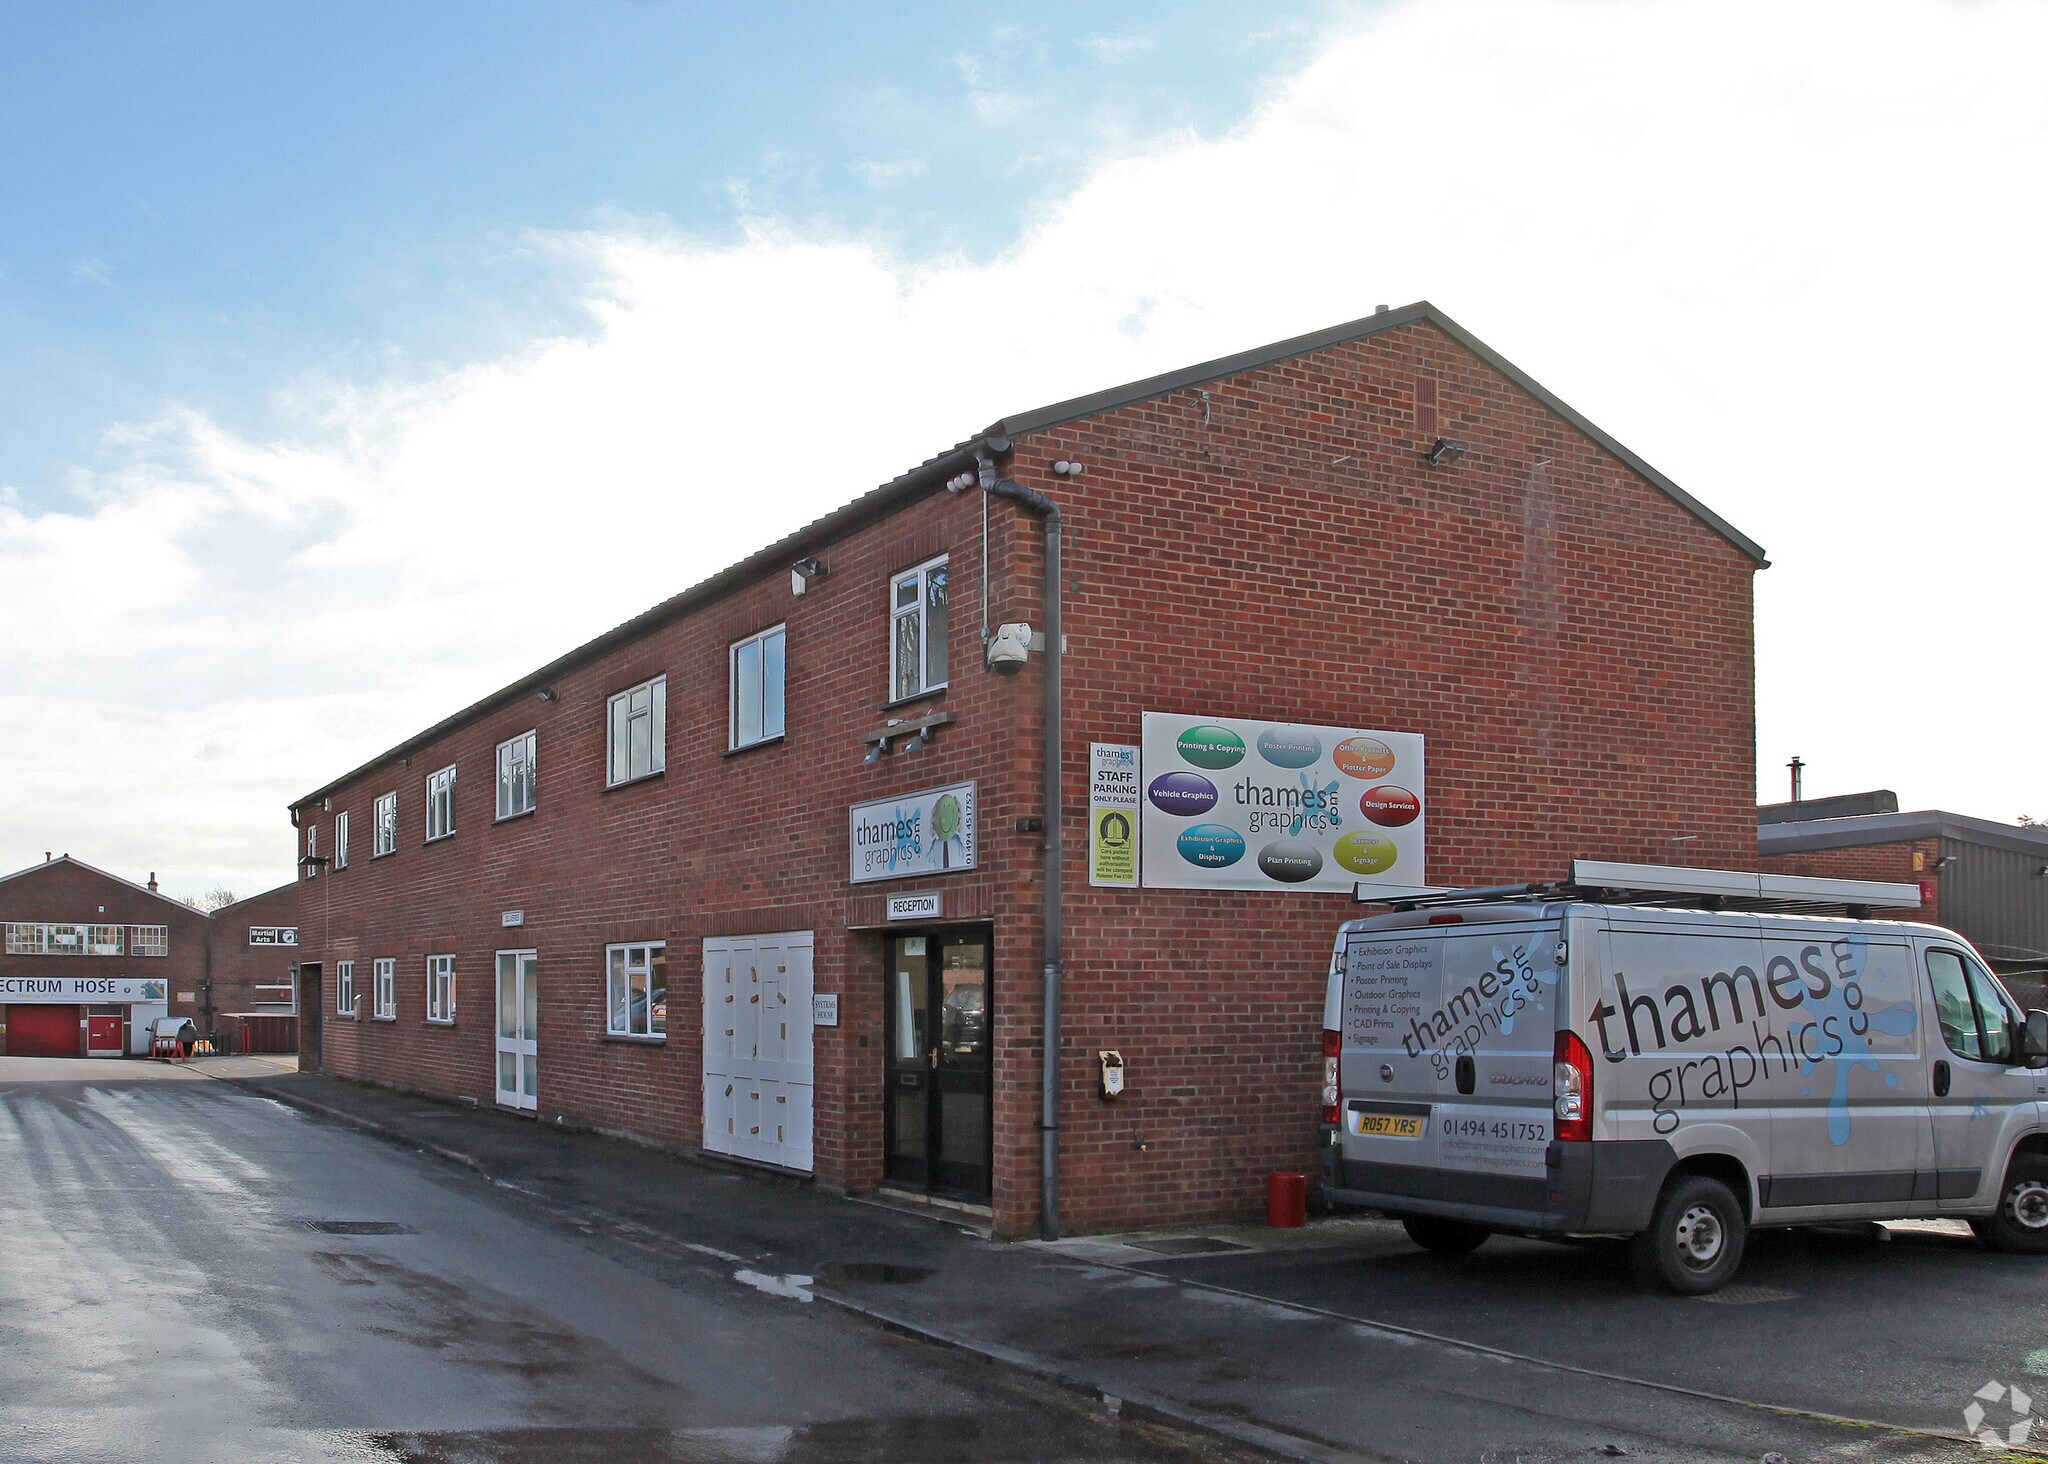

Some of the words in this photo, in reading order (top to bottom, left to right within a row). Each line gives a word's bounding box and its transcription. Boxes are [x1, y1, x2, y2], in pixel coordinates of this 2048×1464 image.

[1096, 747, 1130, 759] thames
[1178, 741, 1207, 751] Printing
[1216, 744, 1245, 754] Copying
[1264, 742, 1286, 750] Poster
[1288, 744, 1316, 753] Printing
[1360, 746, 1390, 754] Products
[1342, 764, 1366, 772] Plotter
[1367, 766, 1387, 774] Paper
[1097, 770, 1133, 782] STAFF
[1093, 783, 1137, 794] PARKING
[1153, 789, 1180, 798] Vehicle
[1181, 791, 1214, 800] Graphics
[1233, 777, 1328, 808] thames
[1365, 800, 1387, 809] Design
[1389, 802, 1415, 810] Services
[1249, 807, 1327, 834] graphics
[856, 817, 913, 846] thames
[864, 843, 913, 872] graphics
[1198, 853, 1225, 861] Displays
[1267, 856, 1283, 864] Plan
[1284, 857, 1312, 866] Printing
[1353, 856, 1378, 864] Signage
[893, 899, 934, 912] RECEPTION
[1358, 947, 1393, 957] Exhibition
[1395, 945, 1428, 956] Graphics
[1356, 961, 1375, 970] Point
[1377, 960, 1385, 969] of
[1386, 960, 1400, 969] Sale
[1402, 959, 1432, 970] Displays
[74, 980, 116, 993] HOSE
[1355, 976, 1378, 985] Poster
[1380, 975, 1408, 986] Printing
[1354, 990, 1386, 1000] Outdoor
[1388, 989, 1421, 1000] Graphics
[1353, 1004, 1381, 1016] Printing
[1382, 1005, 1388, 1013] &
[1390, 1004, 1421, 1016] Copying
[1402, 958, 1515, 1058] thames
[1587, 945, 1832, 1064] thames
[1353, 1019, 1372, 1028] CAD
[1373, 1020, 1394, 1028] Prints
[1353, 1033, 1378, 1045] Signage
[1430, 989, 1526, 1081] graphics
[1490, 1073, 1548, 1086] DUCATO
[1648, 1016, 1844, 1134] graphics
[1362, 1116, 1391, 1131] RO57
[1393, 1118, 1417, 1133] YRS
[1443, 1119, 1486, 1137] 01494
[1491, 1122, 1546, 1141] 451752
[1443, 1139, 1545, 1155] info@thamesgraphics.com
